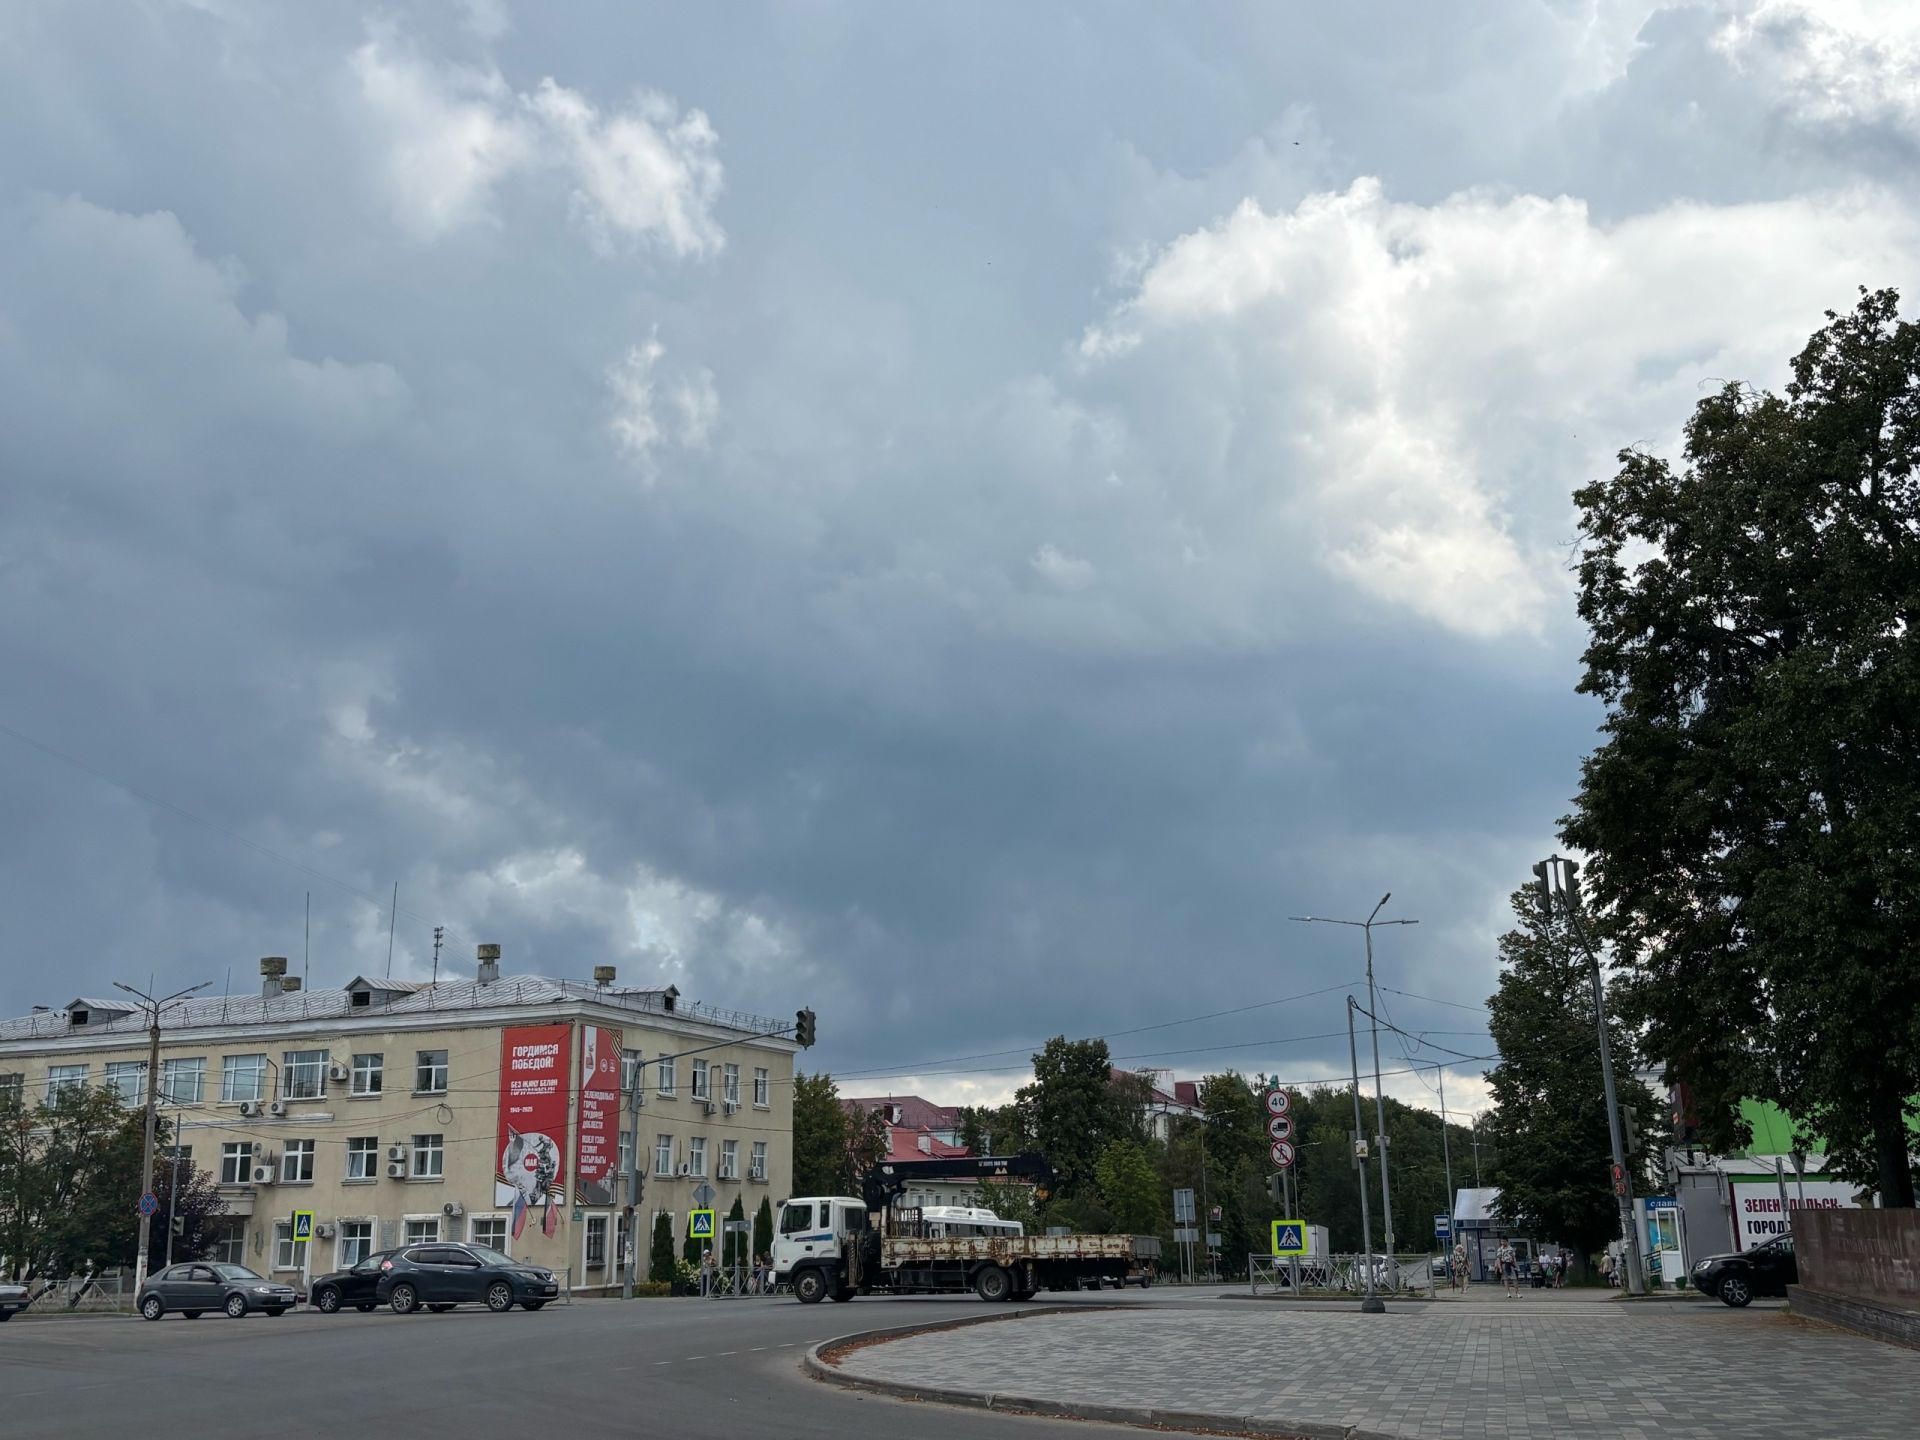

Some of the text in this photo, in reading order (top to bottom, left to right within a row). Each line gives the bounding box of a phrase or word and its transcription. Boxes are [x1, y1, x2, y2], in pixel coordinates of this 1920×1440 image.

[512, 1044, 559, 1057] ГОРДИМСЯ
[511, 1056, 554, 1070] ПОБЕДОЙ!
[1271, 1097, 1285, 1106] 40
[1747, 1220, 1786, 1235] ГОРОД
